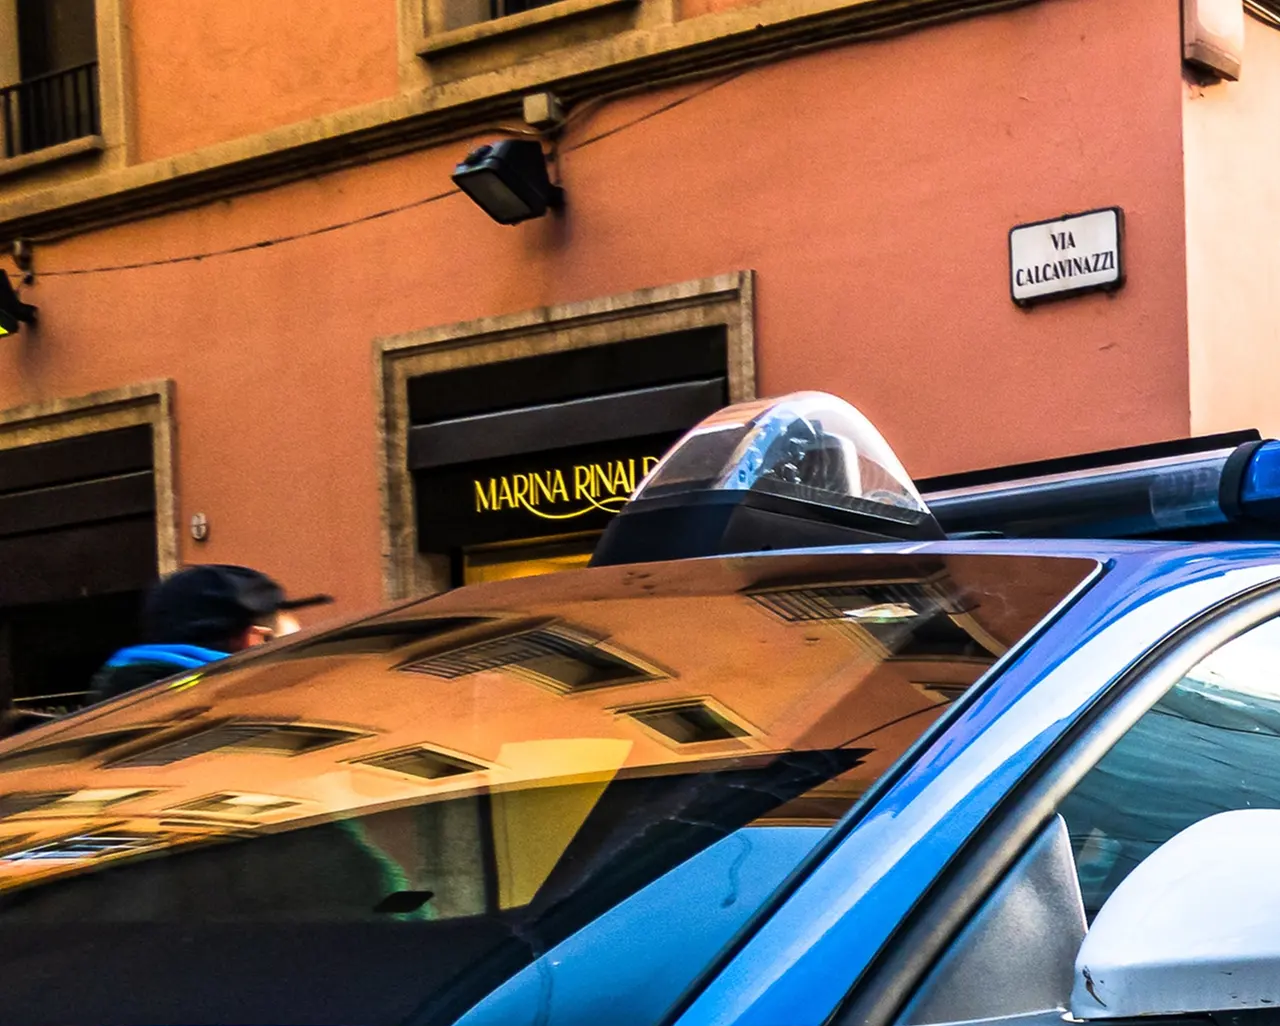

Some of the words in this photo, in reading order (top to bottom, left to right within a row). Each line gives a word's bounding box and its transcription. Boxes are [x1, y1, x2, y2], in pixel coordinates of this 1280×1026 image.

[1050, 231, 1076, 250] VIA
[1016, 251, 1115, 287] CALCAVINAZZI
[474, 469, 569, 514] MARINA
[573, 456, 662, 501] RINAL
